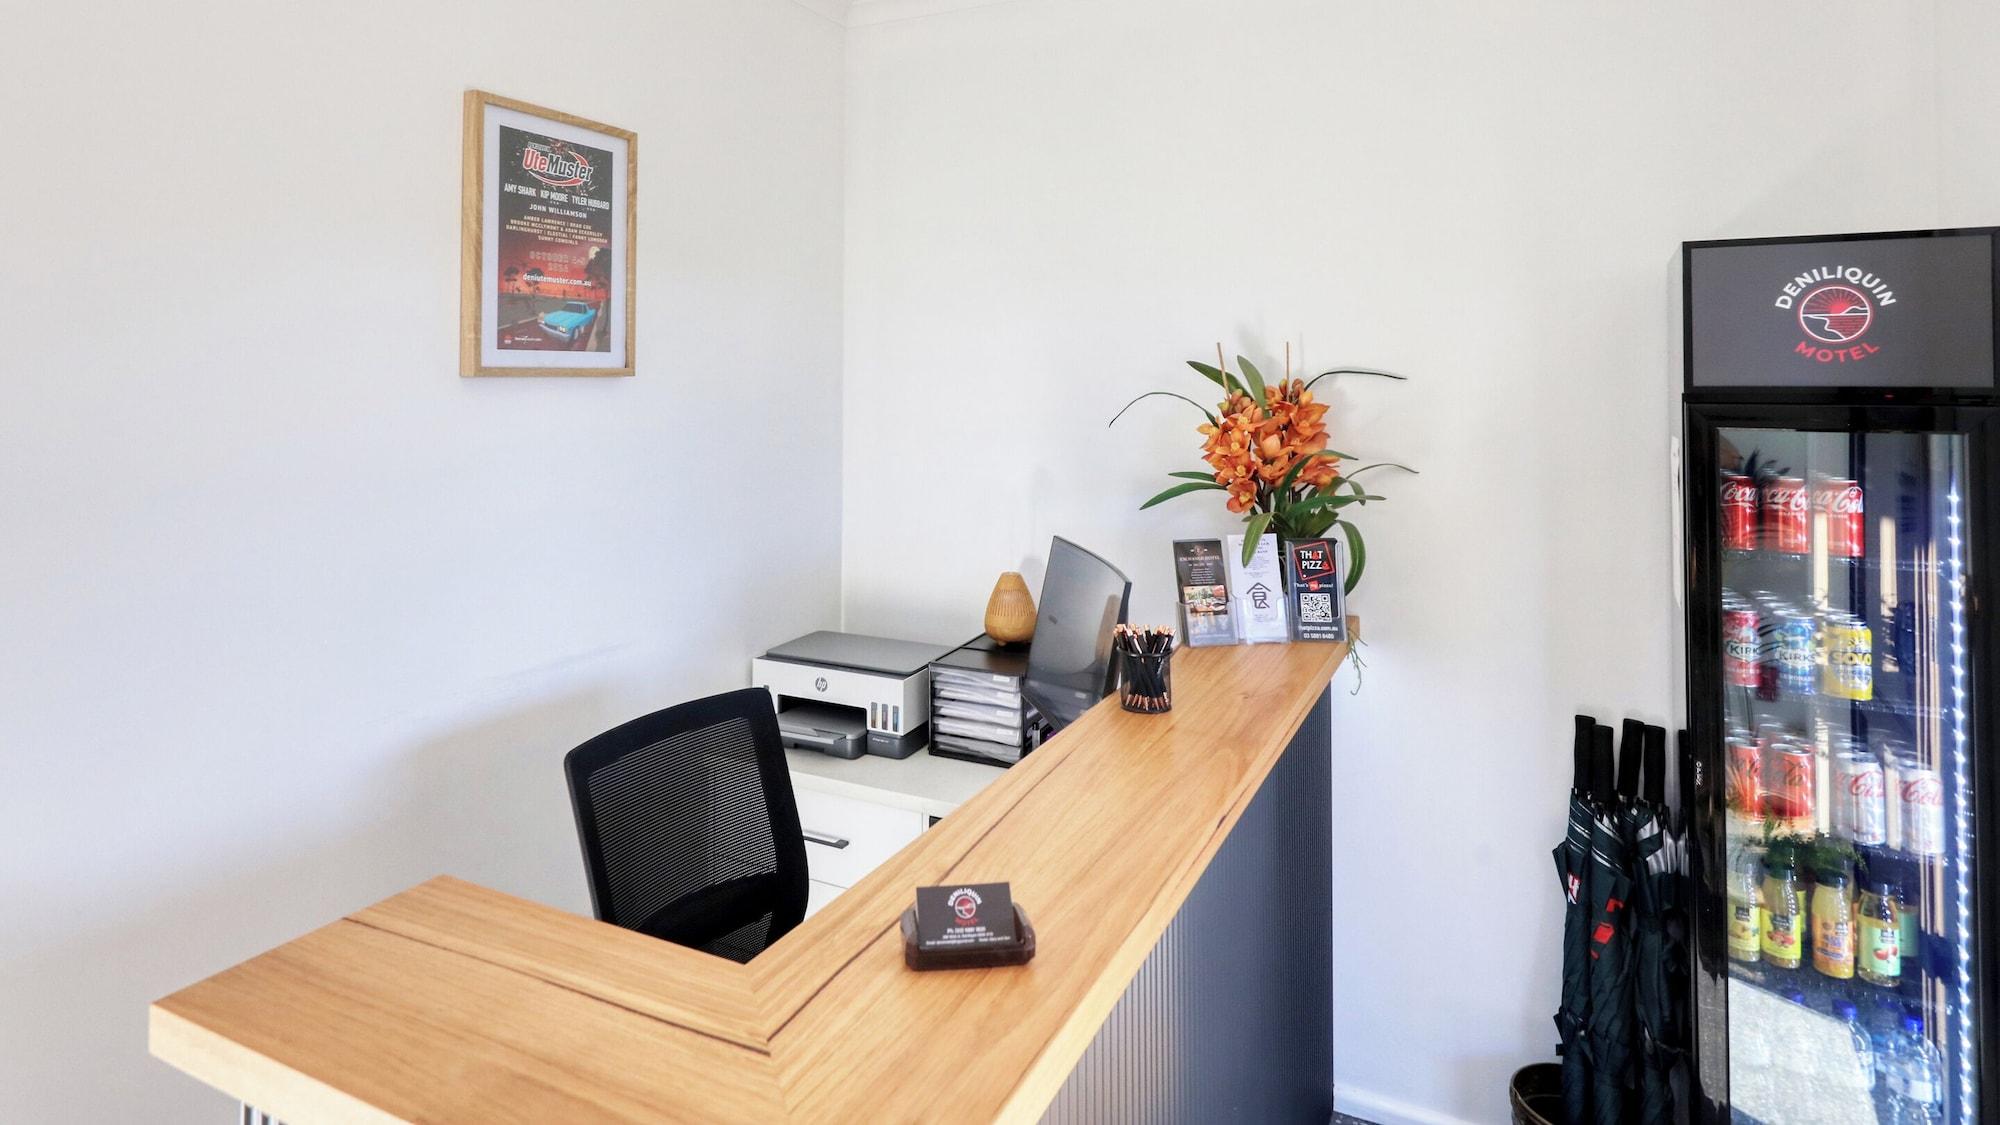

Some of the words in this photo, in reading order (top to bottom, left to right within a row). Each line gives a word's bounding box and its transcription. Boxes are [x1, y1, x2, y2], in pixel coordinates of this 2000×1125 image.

[523, 148, 593, 182] UteMuster
[504, 183, 517, 193] AMY
[517, 184, 537, 197] SHARK
[540, 190, 550, 200] KIP
[550, 191, 568, 203] MOORE
[572, 195, 587, 207] TYLER
[587, 199, 610, 210] HUBBARD
[529, 203, 547, 212] JOHN
[548, 206, 587, 219] WILLIAMSON
[523, 215, 540, 223] AMBER
[541, 217, 566, 227] LAWRENCE
[522, 273, 592, 287] deniutemuster.com.au
[1775, 265, 1897, 310] DENILIQUIN
[1793, 340, 1881, 363] MOTEL
[1299, 550, 1323, 560] THAT
[1301, 560, 1329, 570] PIZZA
[1246, 581, 1272, 609] 食
[815, 676, 828, 692] hp
